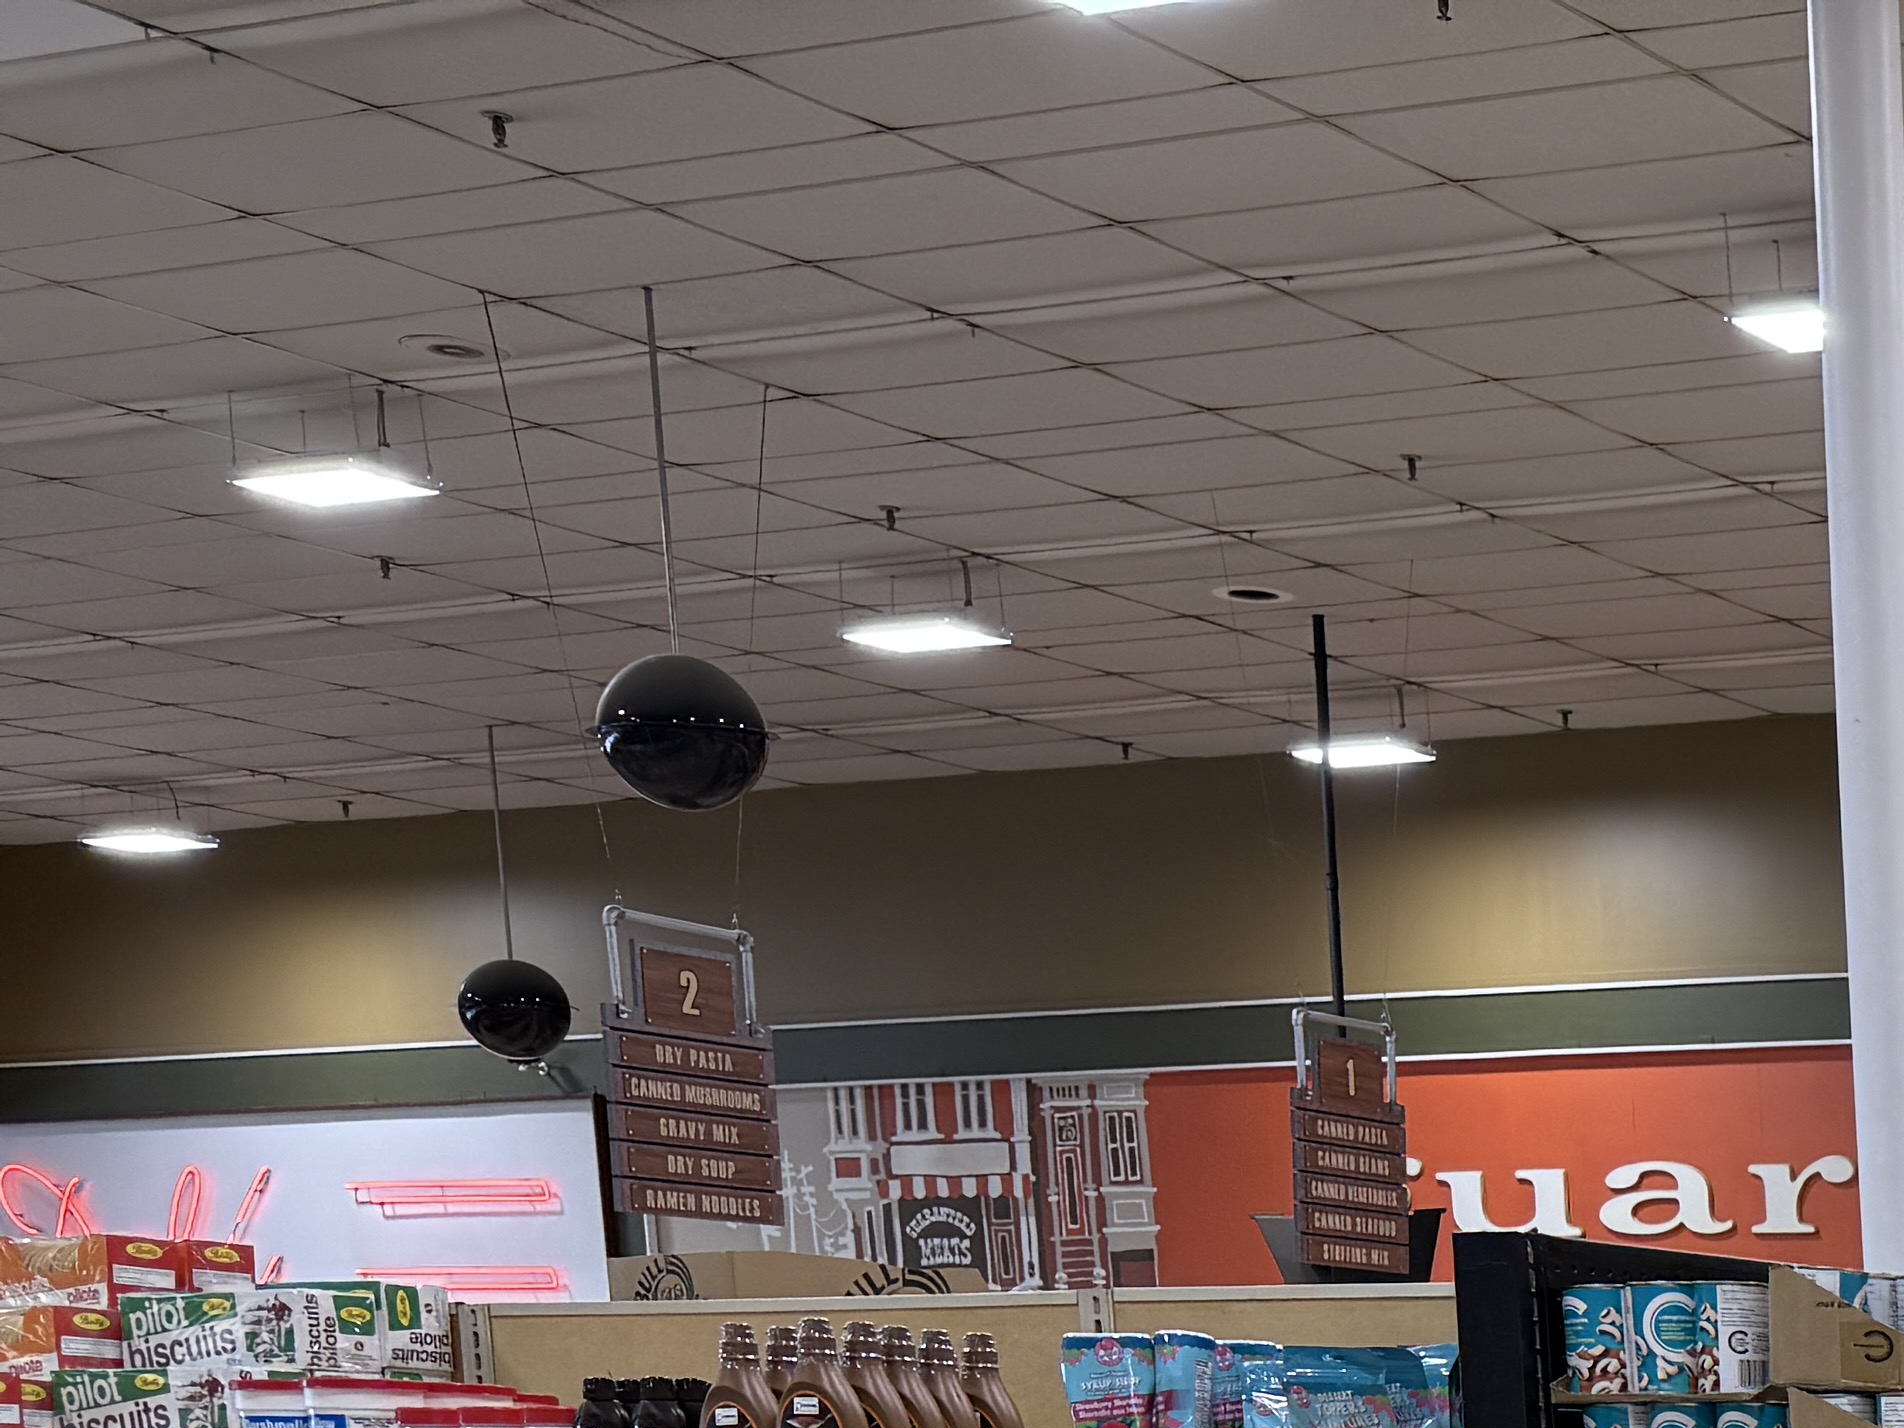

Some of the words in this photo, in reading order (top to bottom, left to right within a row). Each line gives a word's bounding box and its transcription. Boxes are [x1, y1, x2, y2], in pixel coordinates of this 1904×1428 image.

[679, 970, 701, 1016] 2
[655, 1044, 683, 1065] DRY
[690, 1048, 733, 1072] PASTA
[1346, 1059, 1357, 1096] 1
[630, 1077, 681, 1102] CANNED
[685, 1083, 762, 1112] MUSHROOMS
[660, 1118, 706, 1141] GRAVY
[712, 1124, 740, 1145] MIX
[1317, 1119, 1354, 1140] CANNED
[1358, 1124, 1388, 1146] PASTA
[667, 1154, 694, 1176] DRY
[701, 1158, 736, 1179] SOUP
[1317, 1150, 1355, 1171] CANNED
[646, 1189, 697, 1212] RAMEN
[701, 1193, 761, 1217] NOODLES
[1311, 1180, 1346, 1201] CANNED
[1314, 1211, 1352, 1232] CANNED
[918, 1236, 973, 1267] MEATS
[1371, 1247, 1389, 1266] MIX
[129, 1296, 189, 1340] pilot
[127, 1324, 238, 1369] biscuits
[60, 1373, 122, 1412] pilot
